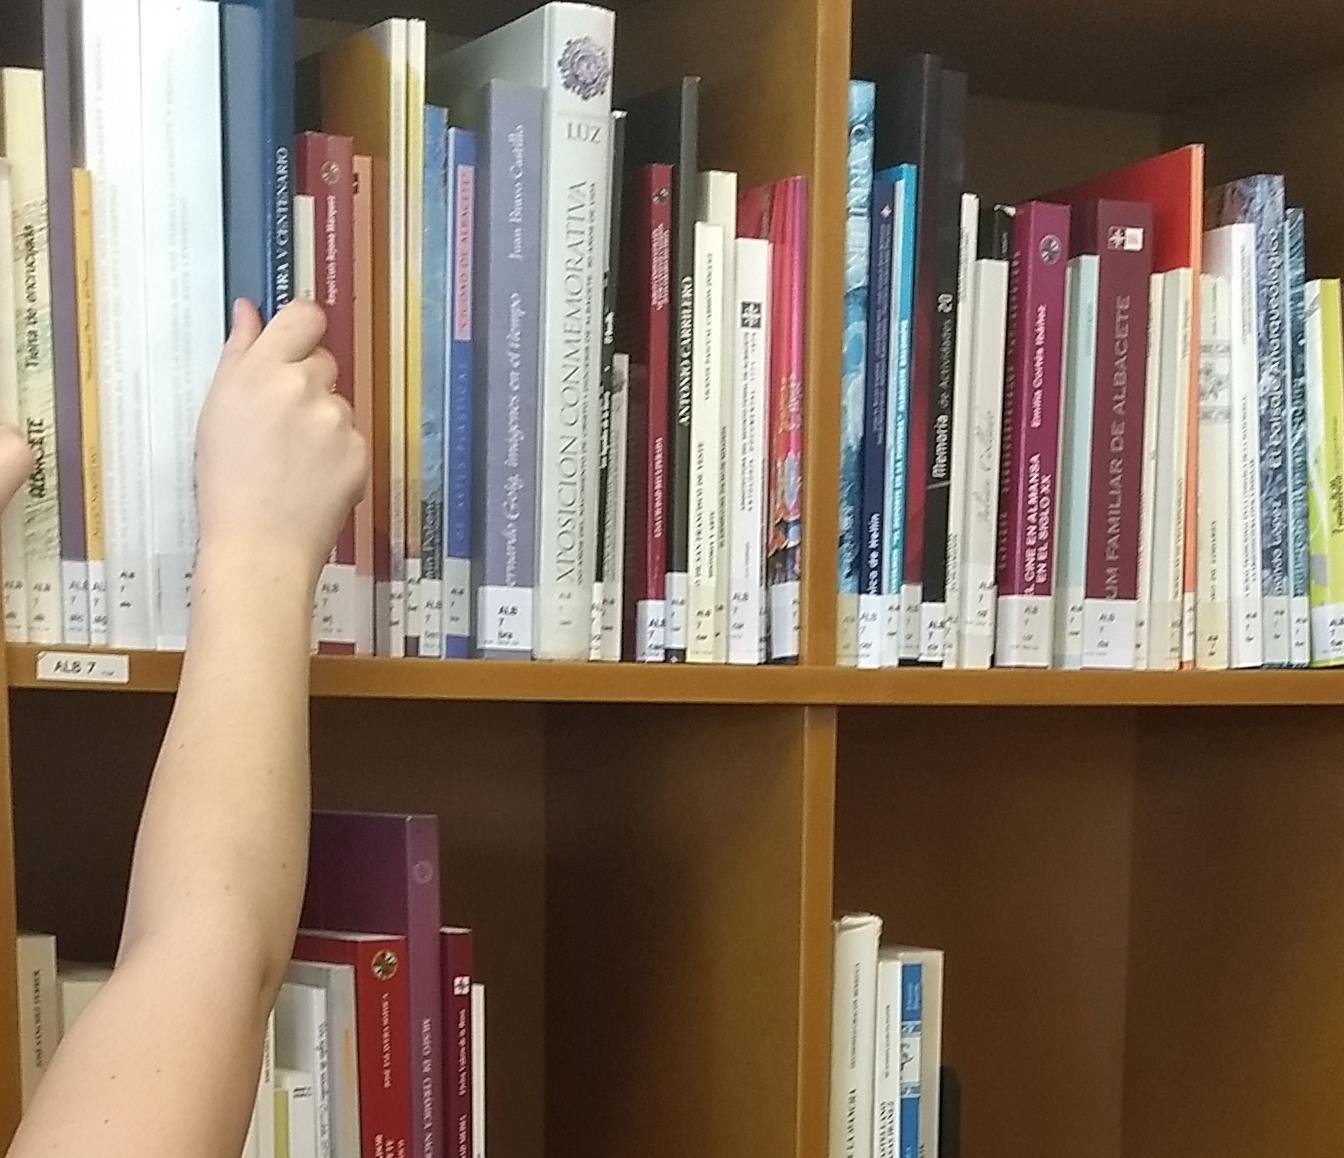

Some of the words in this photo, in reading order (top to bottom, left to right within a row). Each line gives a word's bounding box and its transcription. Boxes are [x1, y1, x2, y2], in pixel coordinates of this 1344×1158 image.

[508, 124, 522, 178] Castillo
[276, 147, 288, 245] CENTENARIO
[508, 227, 522, 258] Juan
[559, 179, 586, 426] CONMEMORATIVA
[678, 276, 692, 357] CARRILERO
[1111, 294, 1130, 415] ALBACETE
[509, 372, 519, 390] en
[678, 360, 692, 424] ANTONIO
[938, 391, 949, 408] de
[931, 414, 948, 477] Memoria
[1110, 420, 1125, 450] DE
[1269, 449, 1282, 467] El
[1026, 453, 1040, 524] ALMANSA
[1039, 473, 1050, 493] XX
[1038, 496, 1050, 539] SIGLO
[1106, 457, 1124, 560] FAMILIAR
[1025, 524, 1037, 545] EN
[1037, 542, 1049, 561] EL
[1024, 547, 1037, 582] CINE
[1036, 562, 1048, 582] EN
